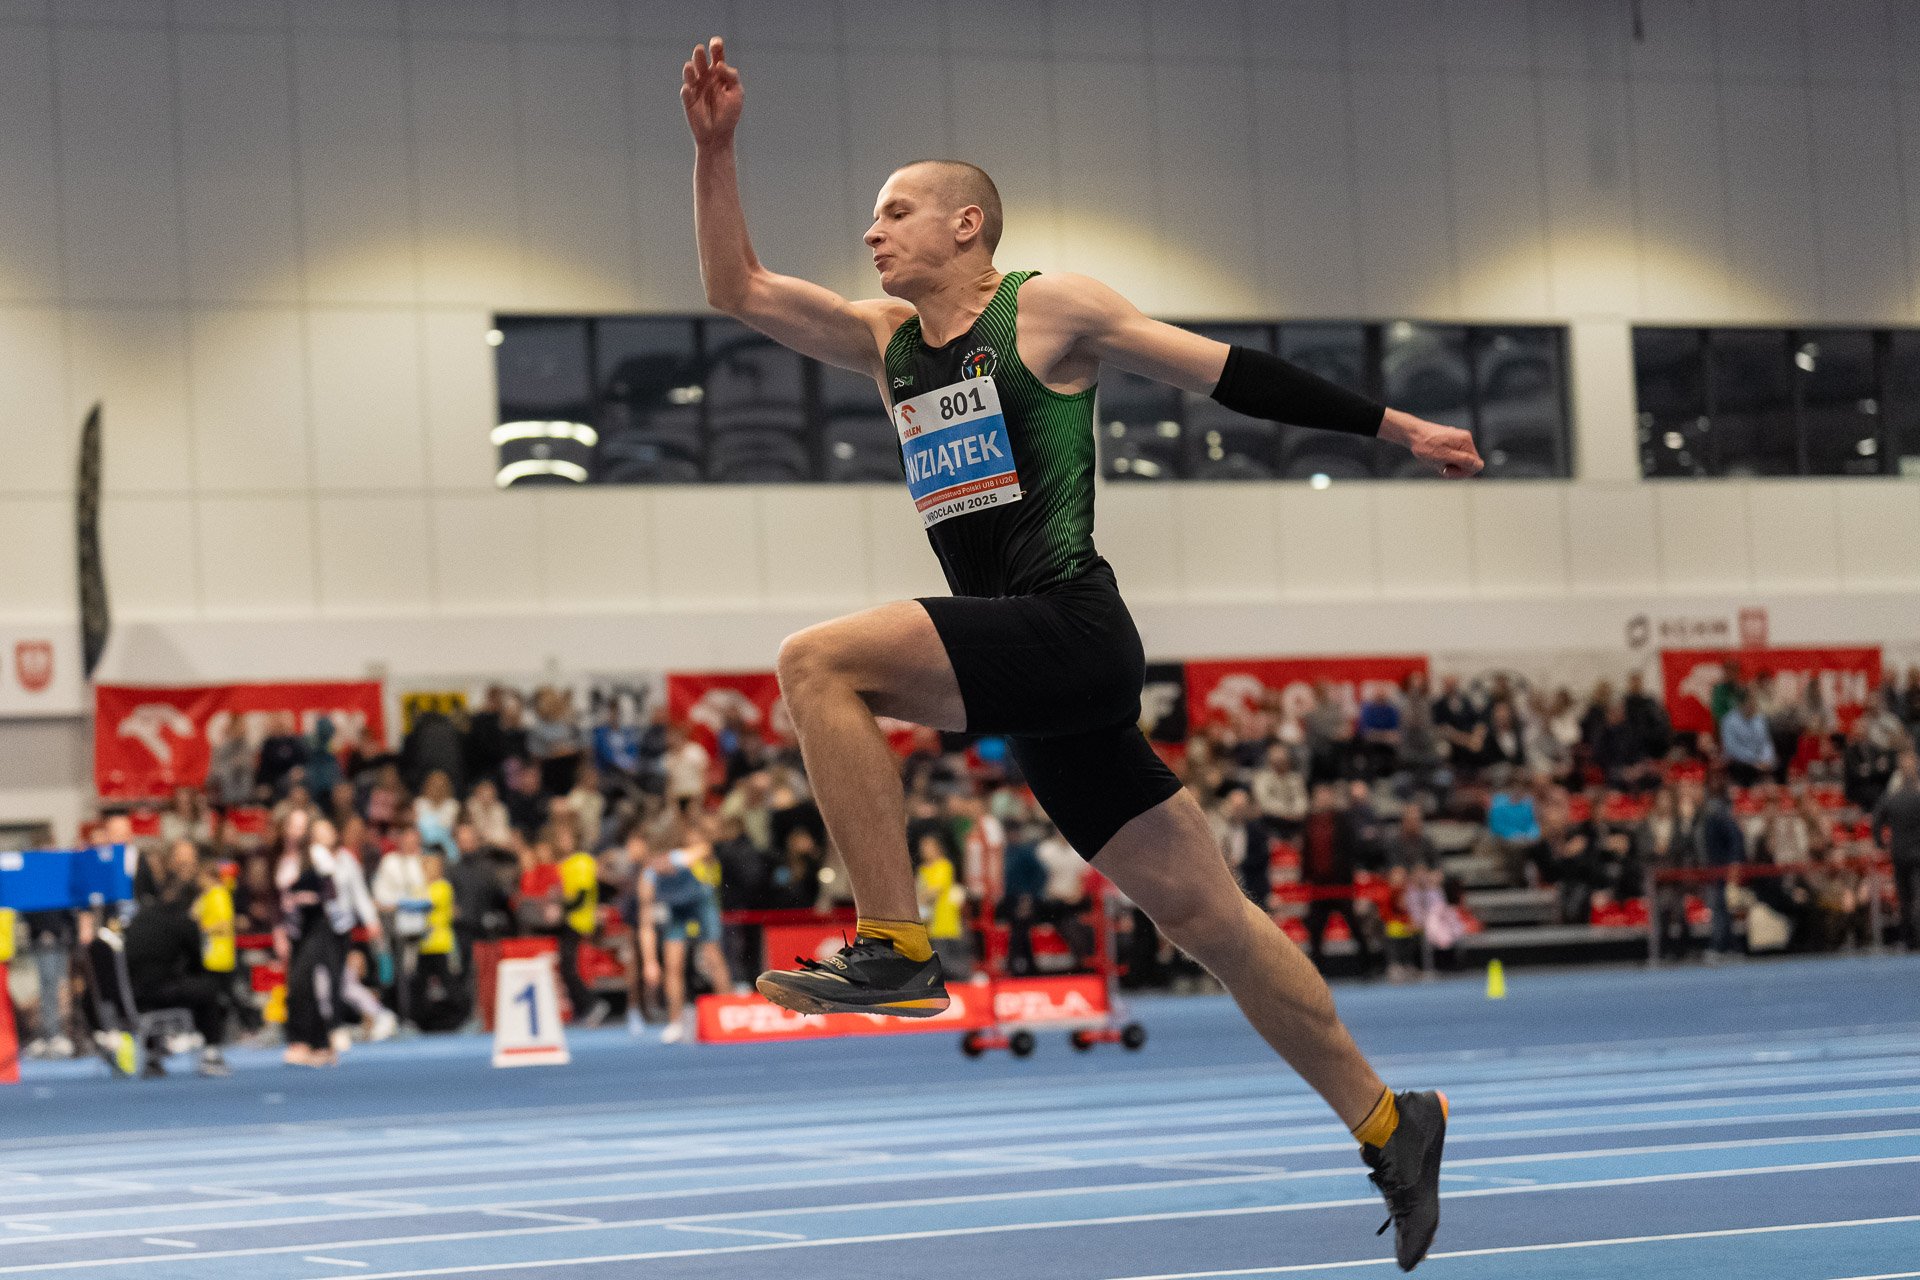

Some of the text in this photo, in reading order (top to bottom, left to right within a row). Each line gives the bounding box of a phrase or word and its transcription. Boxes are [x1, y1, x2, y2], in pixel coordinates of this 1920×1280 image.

[939, 387, 986, 421] 801
[906, 429, 1004, 485] WZIĄTEK
[982, 480, 994, 489] U18
[999, 476, 1014, 485] U20
[925, 501, 965, 523] WROCŁAW
[967, 493, 998, 509] 2025
[513, 982, 539, 1038] 1
